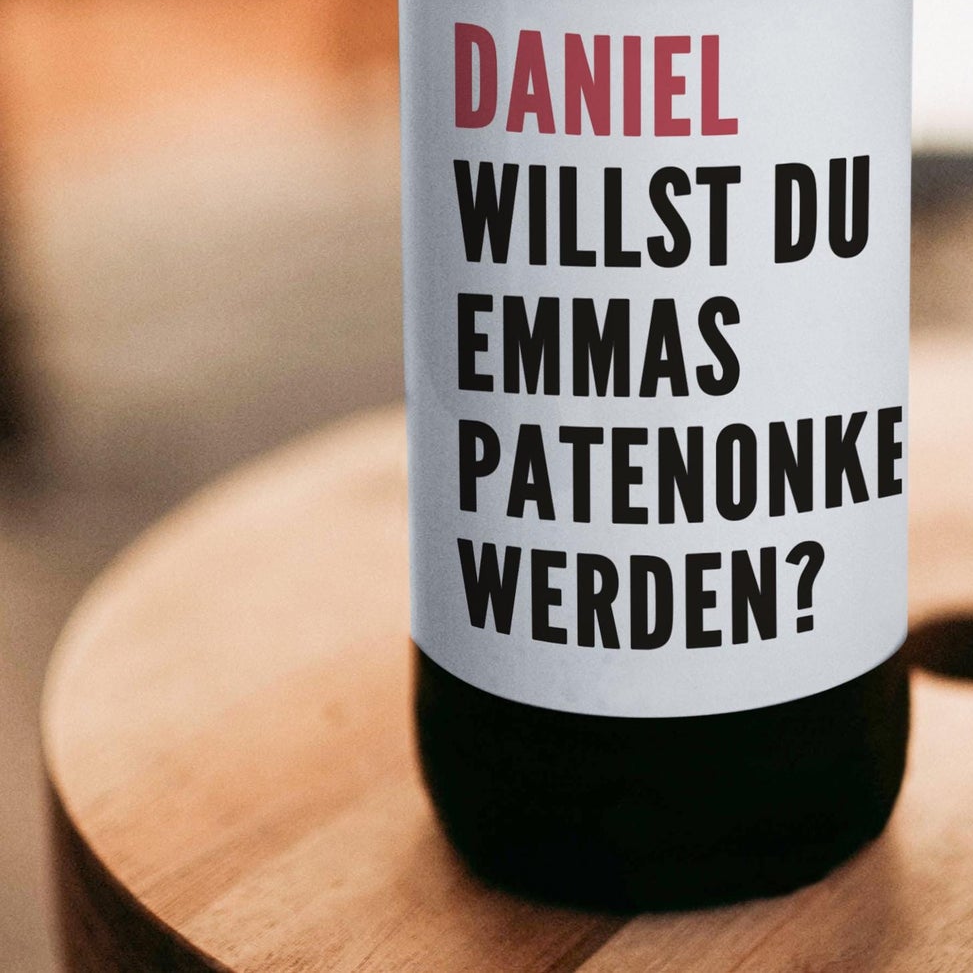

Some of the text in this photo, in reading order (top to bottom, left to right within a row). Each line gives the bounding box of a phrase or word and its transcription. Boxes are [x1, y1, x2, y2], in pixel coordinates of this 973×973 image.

[454, 21, 739, 137] DANIEL
[452, 154, 870, 269] WILLST DU
[456, 292, 741, 398] EMMAS
[457, 405, 903, 525] PATENONKE
[456, 536, 825, 651] WERDEN?
